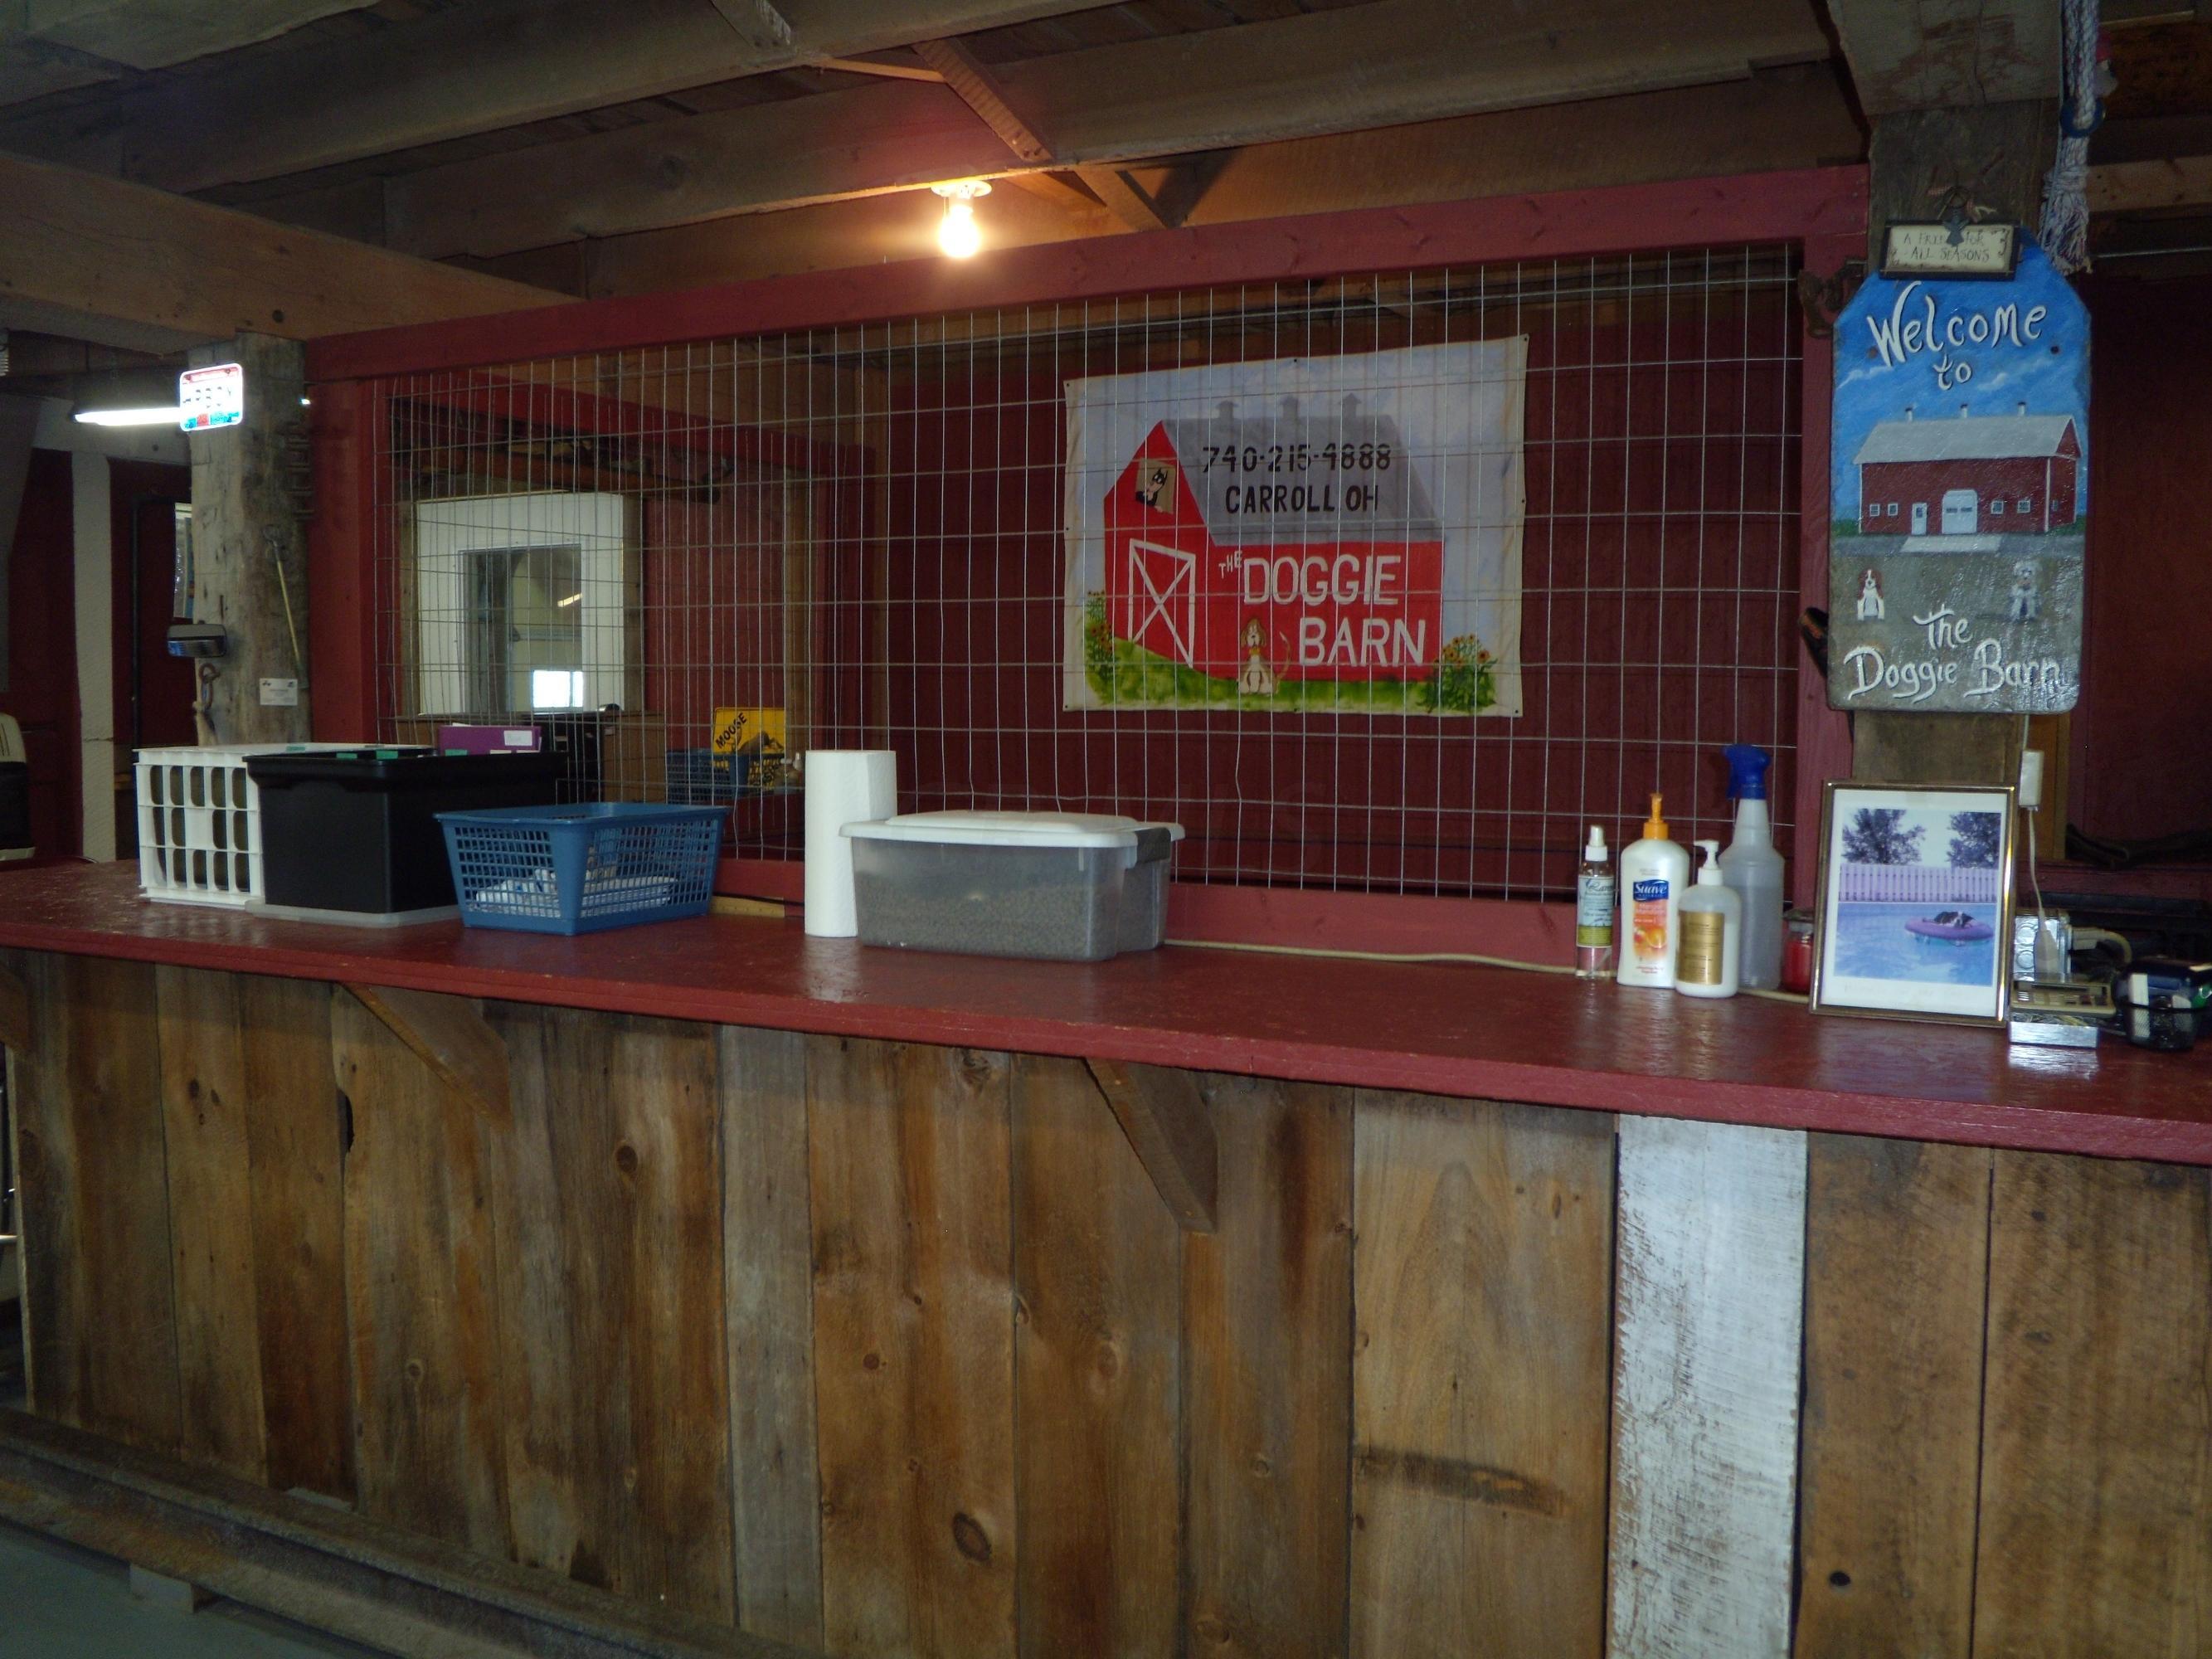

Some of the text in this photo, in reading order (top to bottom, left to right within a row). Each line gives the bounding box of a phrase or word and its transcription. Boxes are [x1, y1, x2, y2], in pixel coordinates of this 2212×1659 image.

[1910, 246, 1990, 262] ALL SEASONS
[1918, 231, 1949, 246] FRIE
[1867, 280, 2048, 367] Welcome
[1932, 353, 1971, 391] to
[1345, 484, 1378, 512] OH
[1218, 550, 1402, 606] THE DOGGIE
[1298, 616, 1427, 667] BARN
[1843, 638, 2072, 703] Doggie Barn
[715, 712, 747, 749] MOOSE
[1635, 883, 1667, 894] Suave
